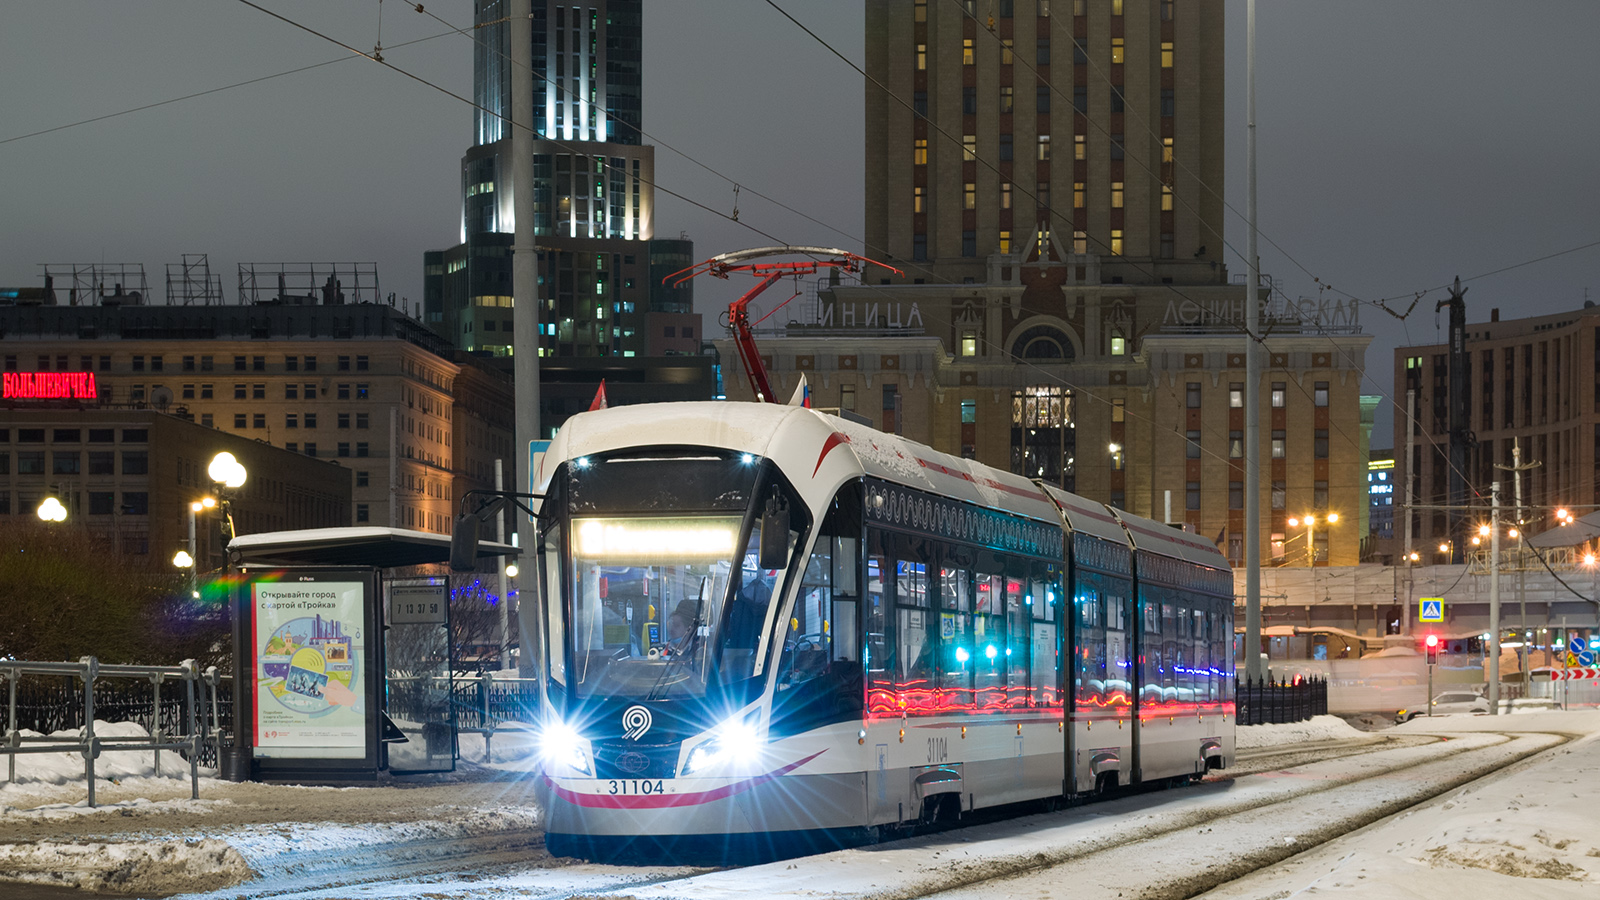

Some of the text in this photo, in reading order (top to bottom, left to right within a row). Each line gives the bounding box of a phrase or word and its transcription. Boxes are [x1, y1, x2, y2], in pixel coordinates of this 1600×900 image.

[1162, 299, 1360, 325] ЛЕНИНРАДСКАЯ
[2, 372, 97, 399] БОЛЬШЕВИЧКА
[261, 590, 336, 601] Открывайте город
[267, 602, 296, 611] картой
[297, 601, 336, 610] «Тройка»
[397, 603, 438, 614] 7 13 37 50
[927, 737, 948, 763] 31104
[608, 780, 664, 795] 31104
